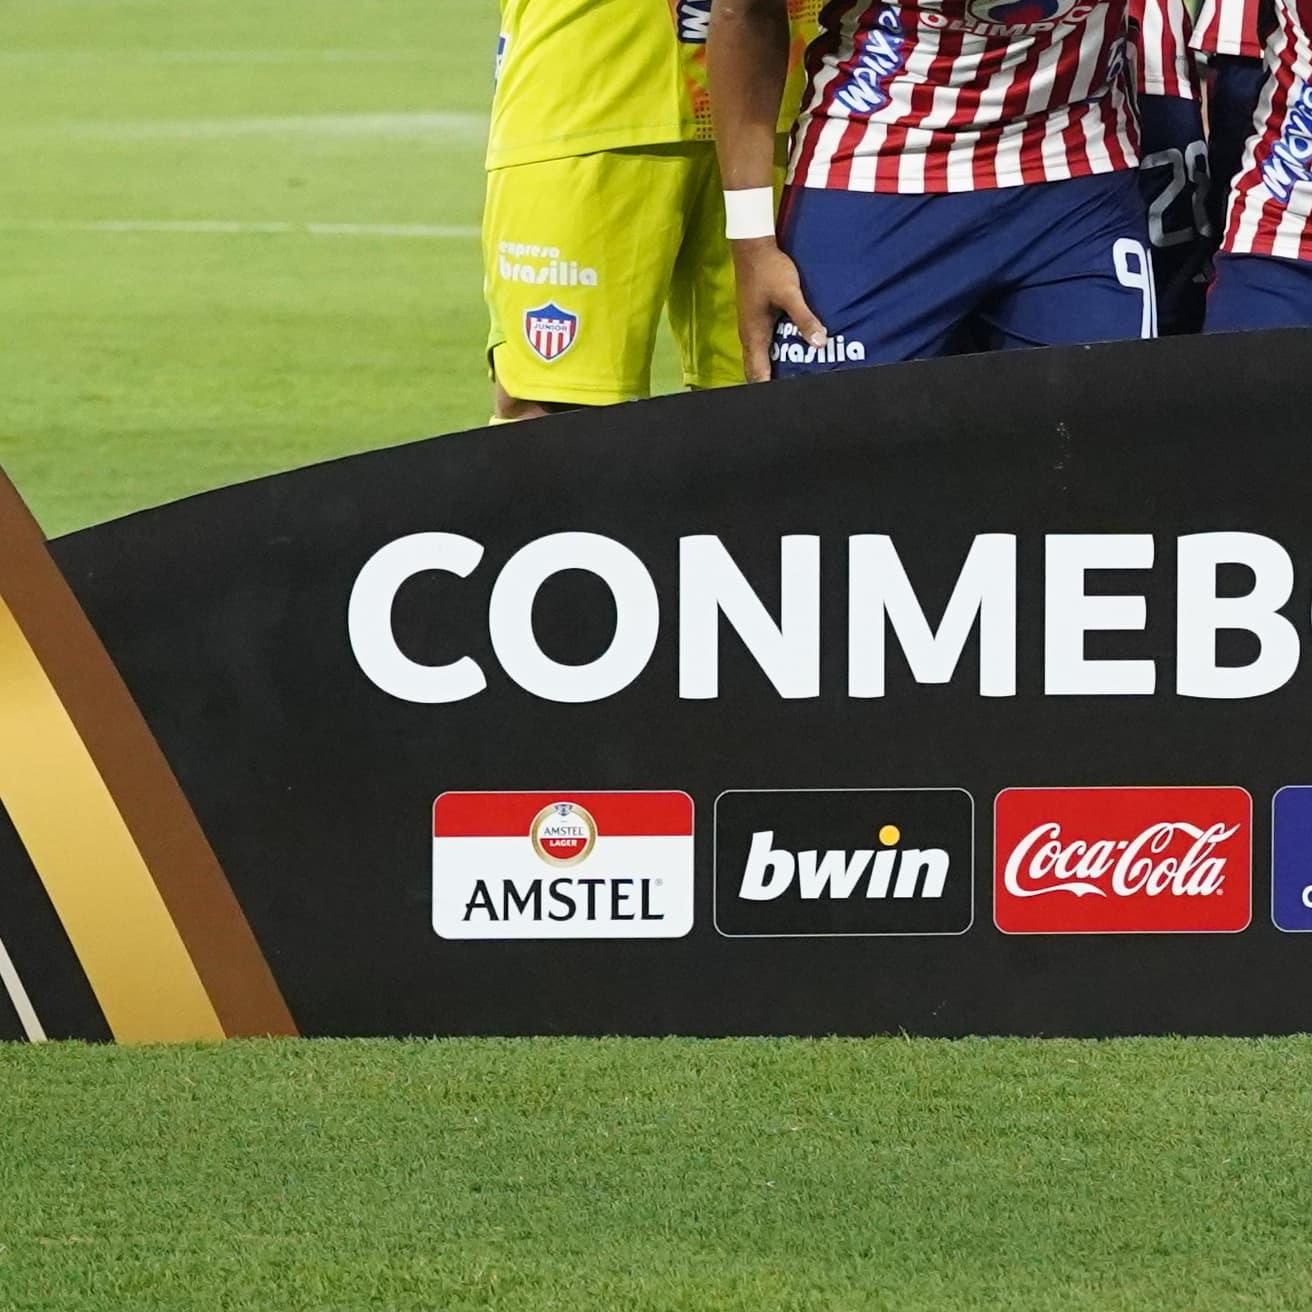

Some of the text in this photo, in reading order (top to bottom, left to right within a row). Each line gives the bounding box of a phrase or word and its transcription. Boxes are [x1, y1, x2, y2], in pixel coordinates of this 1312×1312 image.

[500, 255, 598, 286] brasilia
[544, 826, 584, 836] AMSTEL
[549, 839, 578, 847] LAGER
[738, 825, 950, 902] bwin
[1003, 821, 1242, 898] Coca-Cola
[461, 878, 665, 922] AMSTEL
